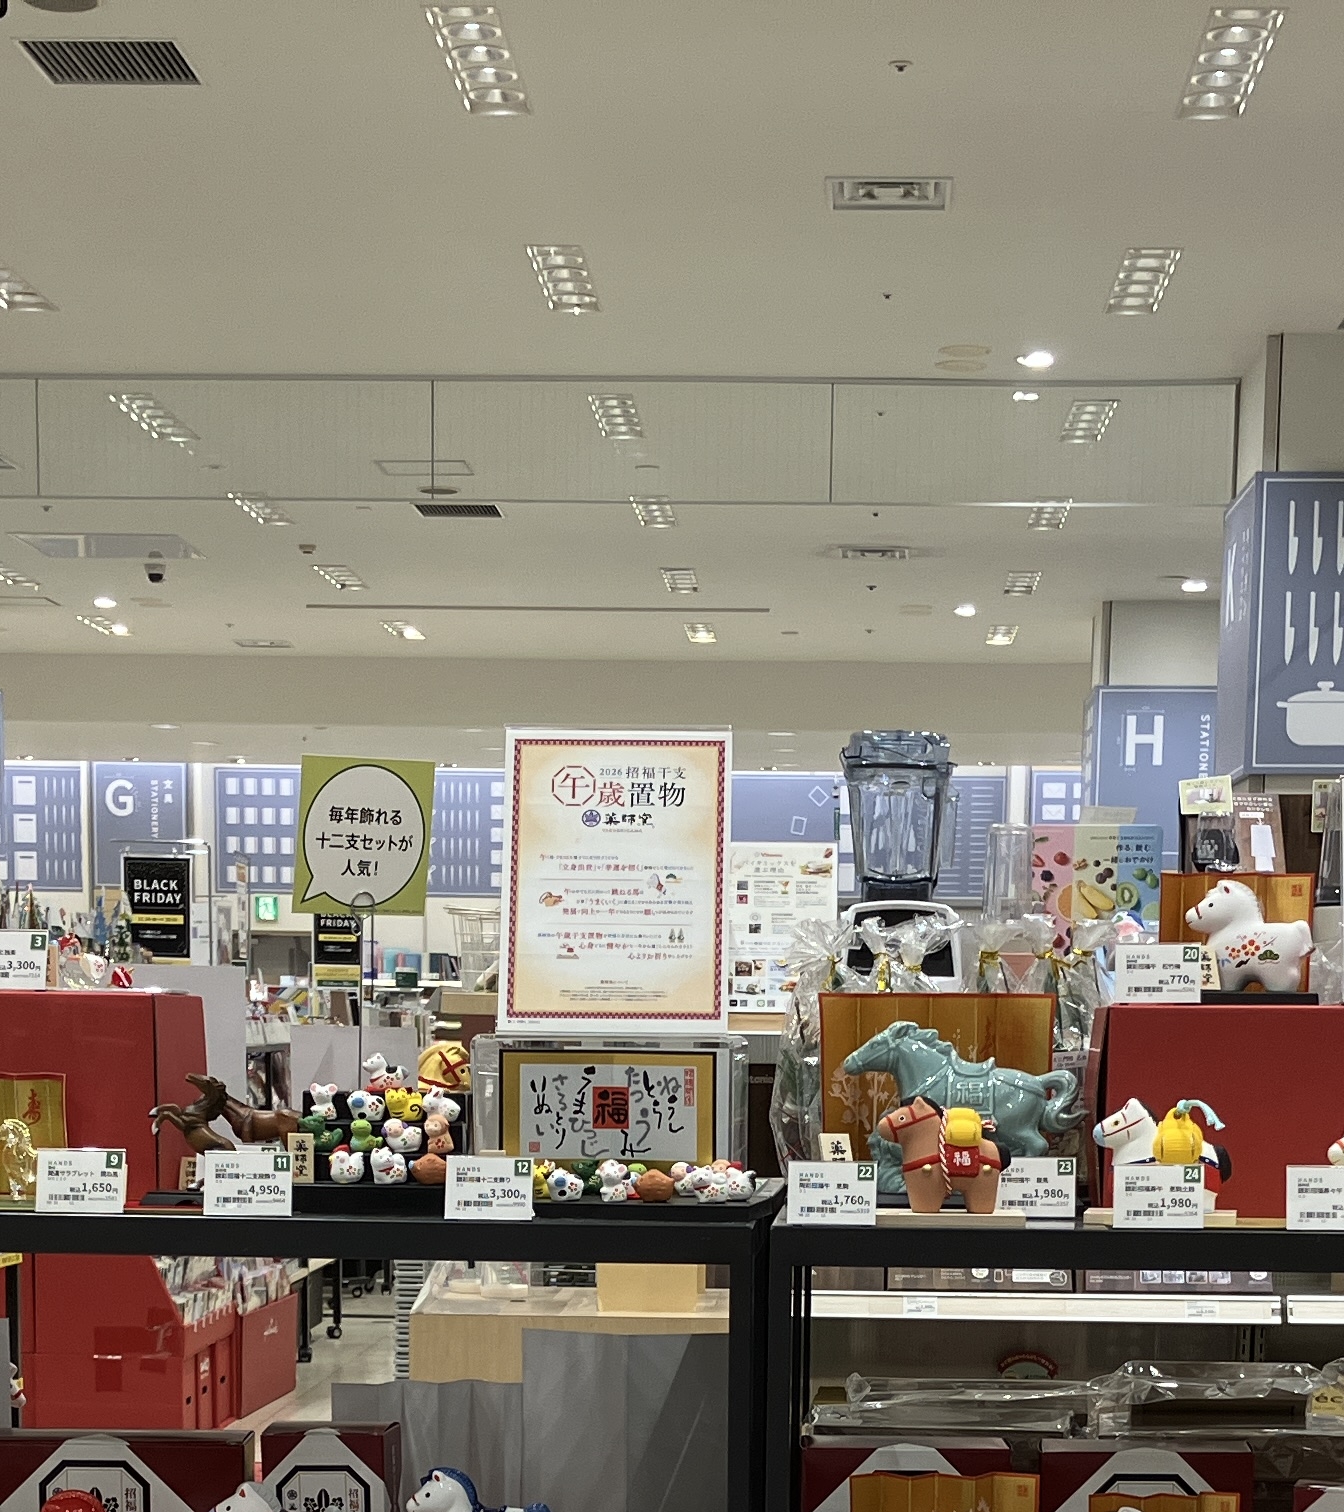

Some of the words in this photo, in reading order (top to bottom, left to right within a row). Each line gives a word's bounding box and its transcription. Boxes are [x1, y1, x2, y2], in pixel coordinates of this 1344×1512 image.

[1125, 715, 1163, 766] H
[600, 768, 622, 776] 2026
[626, 766, 686, 779] 招福干支
[105, 779, 134, 817] G
[151, 780, 159, 838] STATIONERY
[328, 806, 402, 825] 毎年飾れる
[315, 832, 413, 851] 十二支セットが
[134, 879, 179, 891] BLACK
[134, 891, 181, 904] FRIDAY
[33, 937, 43, 946] 3
[1183, 948, 1198, 962] 20
[594, 1089, 629, 1126] 福
[953, 1152, 971, 1167] 福
[516, 1163, 529, 1174] 12
[858, 1167, 873, 1179] 22
